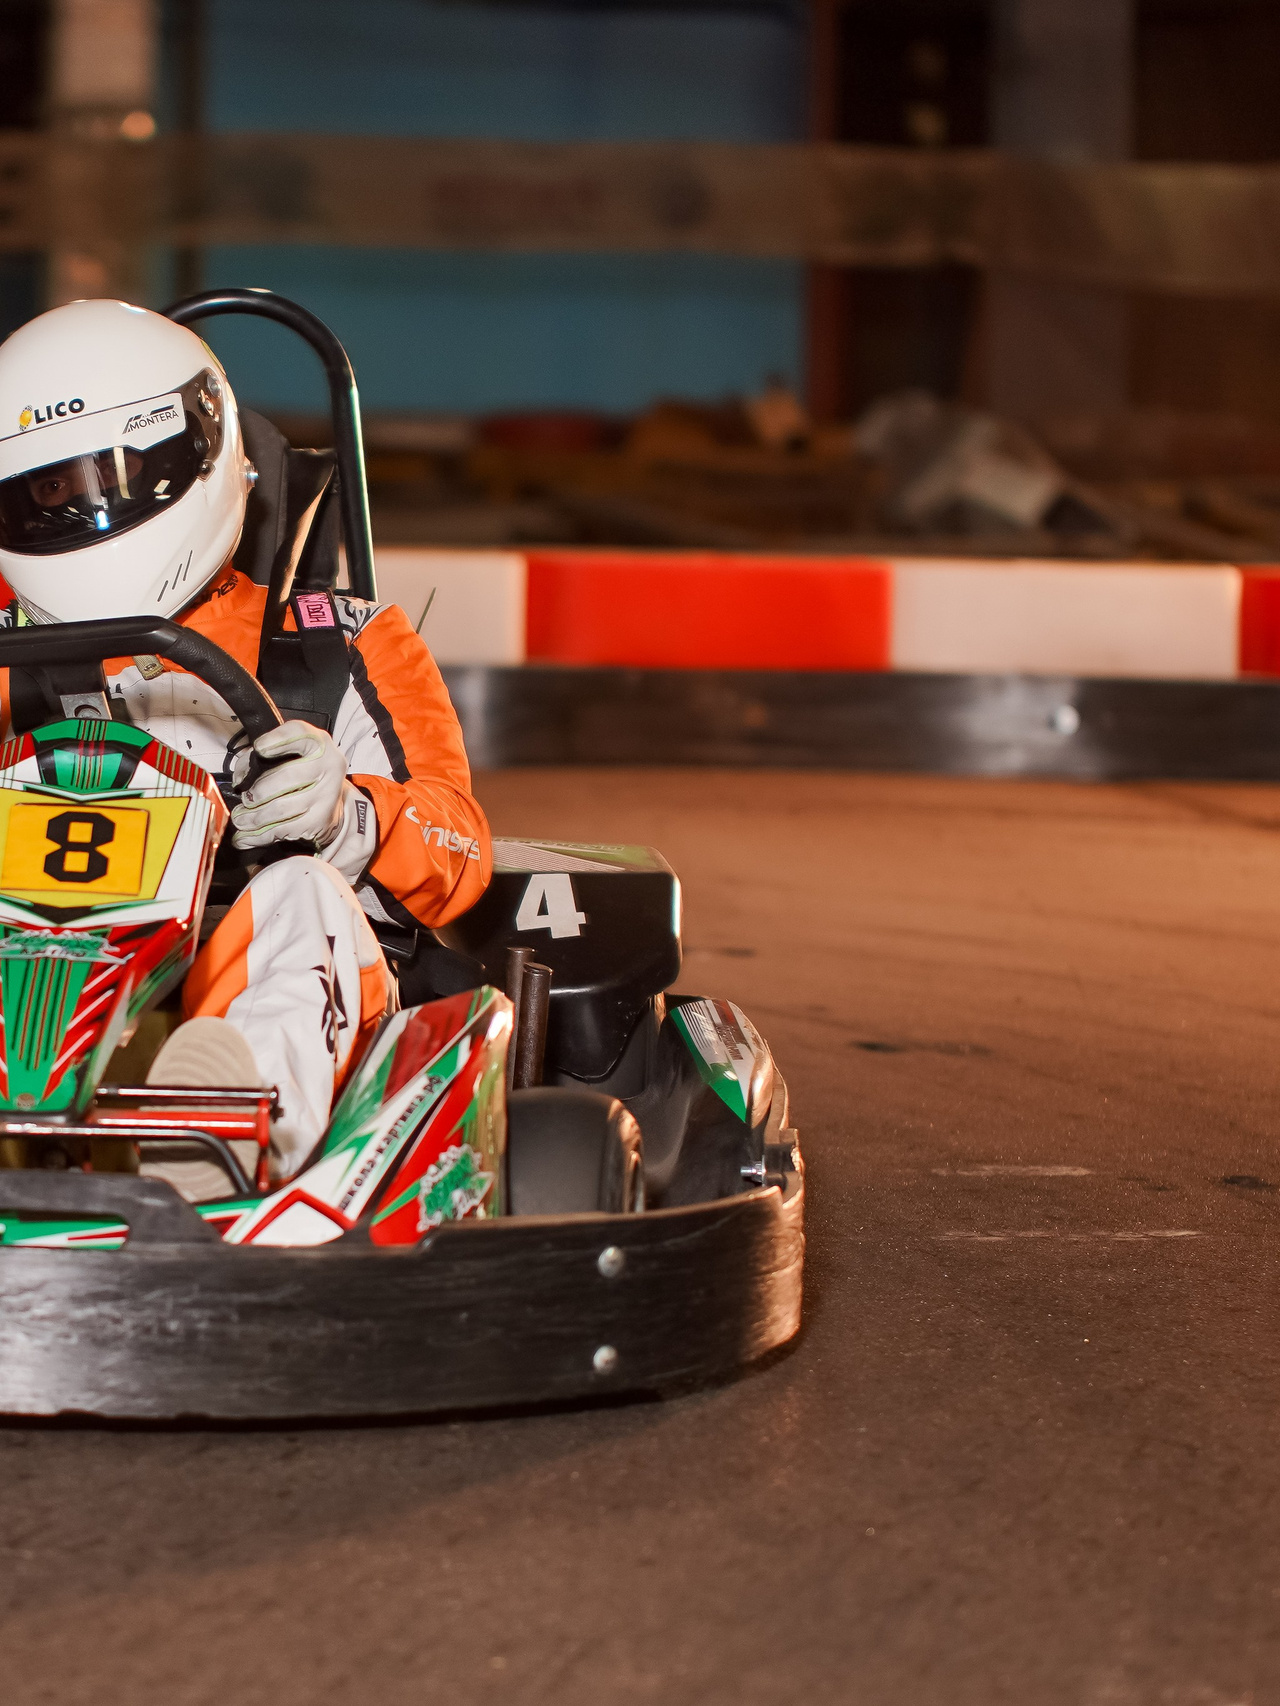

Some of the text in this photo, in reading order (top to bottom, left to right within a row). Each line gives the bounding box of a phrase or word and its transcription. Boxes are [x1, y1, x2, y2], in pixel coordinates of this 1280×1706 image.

[33, 397, 86, 425] LICO
[127, 409, 180, 432] MONTERA
[43, 811, 116, 883] 8
[515, 873, 587, 939] 4
